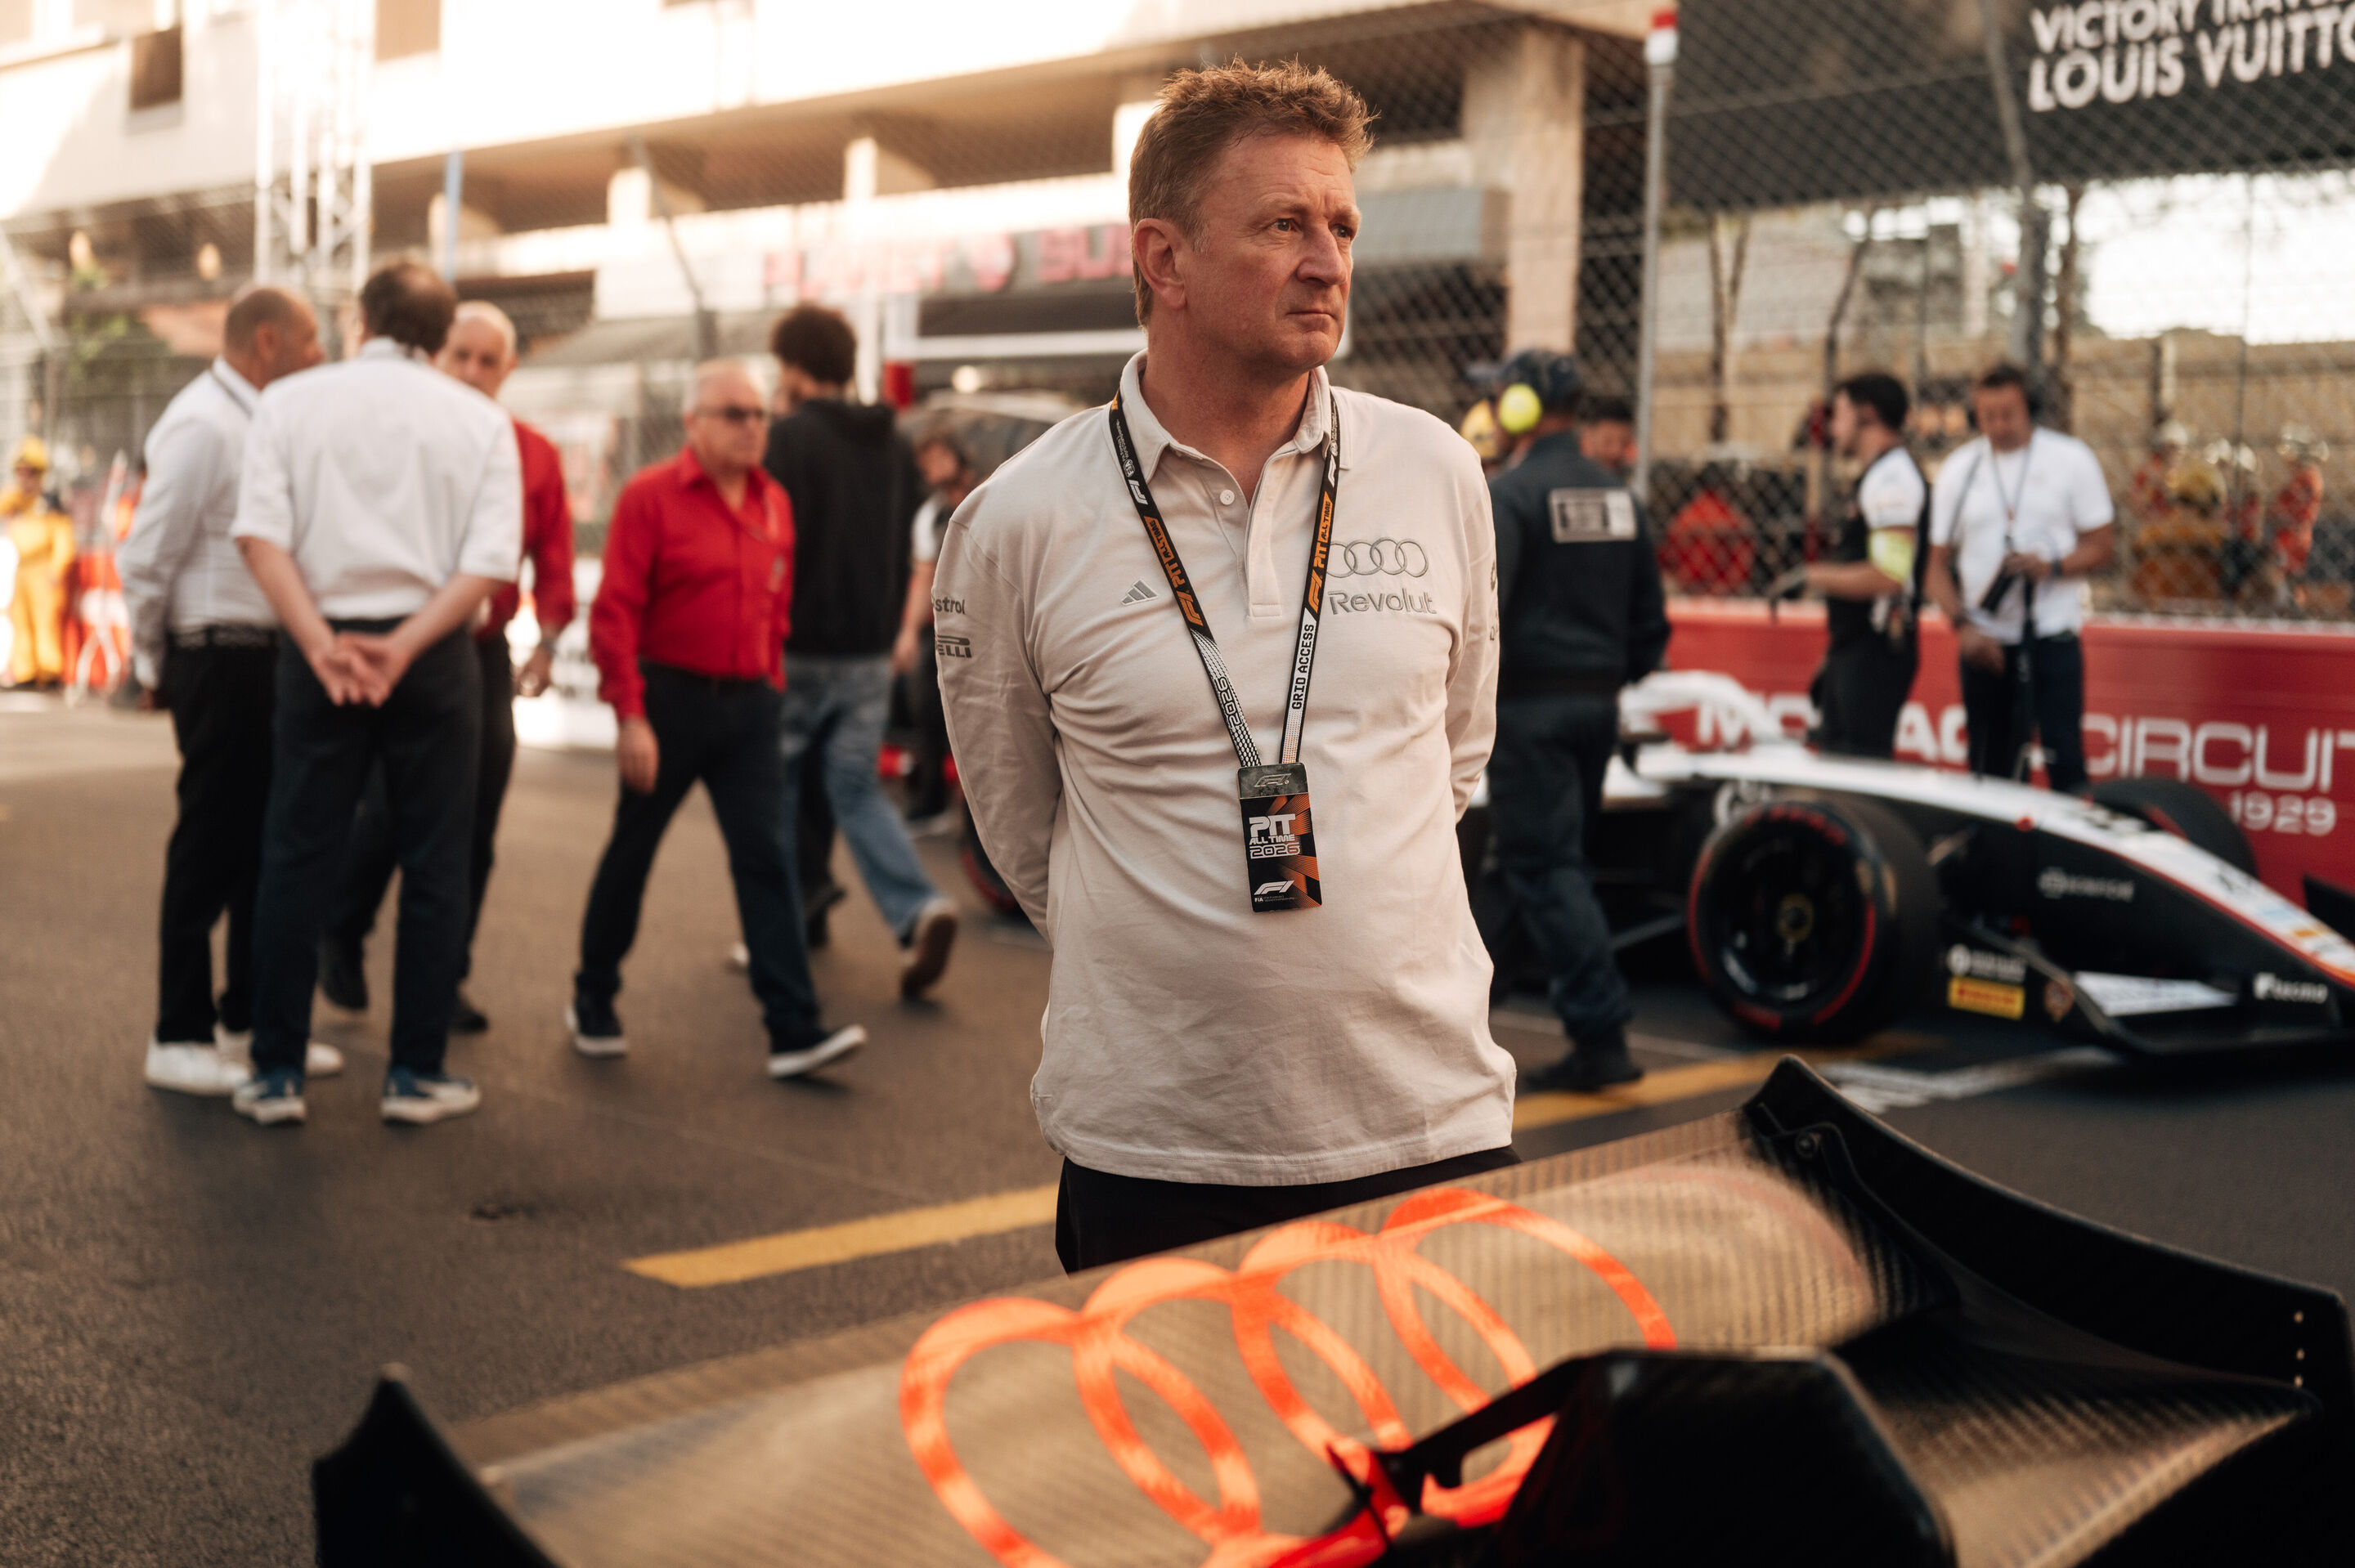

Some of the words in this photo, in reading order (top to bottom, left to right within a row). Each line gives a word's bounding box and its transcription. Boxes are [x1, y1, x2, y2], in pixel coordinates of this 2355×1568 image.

[2028, 37, 2186, 112] LOUIS
[1150, 519, 1163, 544] TIME
[1313, 541, 1328, 569] PIT
[1322, 500, 1331, 522] TIME
[1160, 544, 1172, 558] ALL
[1164, 561, 1186, 589] PIT
[933, 596, 967, 616] strol
[1328, 587, 1438, 615] Revolut
[1297, 624, 1315, 674] ACCESS
[1214, 676, 1243, 728] 2026
[1291, 677, 1307, 710] GRID
[2081, 712, 2355, 794] CIRCUI
[1249, 813, 1296, 839] PIT
[2230, 790, 2337, 836] 1929
[1249, 836, 1269, 845] ALL
[1270, 834, 1296, 844] TIME
[1249, 843, 1301, 859] 2026
[1254, 880, 1295, 895] F1
